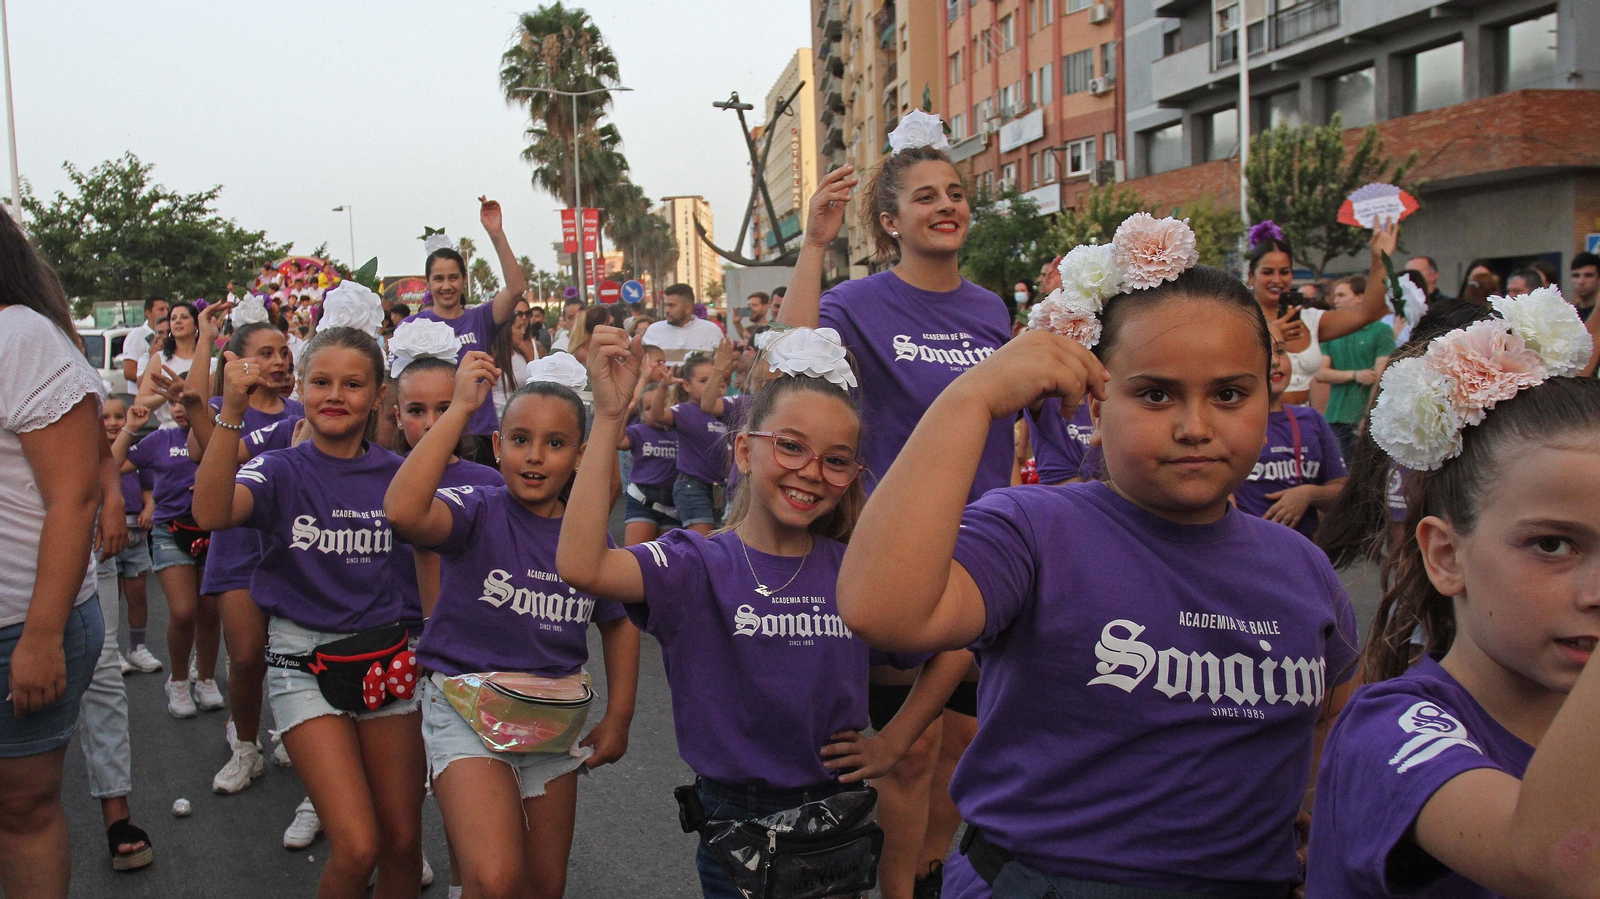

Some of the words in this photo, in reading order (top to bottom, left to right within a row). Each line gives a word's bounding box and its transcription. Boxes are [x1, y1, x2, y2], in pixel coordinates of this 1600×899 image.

[922, 332, 950, 340] ACADEMIA
[951, 332, 959, 340] DE
[331, 509, 362, 518] ACADEMIA
[361, 511, 370, 519] DE
[527, 568, 558, 582] ACADEMIA
[771, 596, 801, 604] ACADEMIA
[802, 596, 810, 604] DE
[811, 596, 826, 604] BAILE
[1179, 610, 1237, 630] ACADEMIA
[1235, 618, 1250, 634] DE
[1249, 620, 1281, 635] BAILE
[1210, 707, 1240, 718] SINCE
[1242, 708, 1266, 720] 1985
